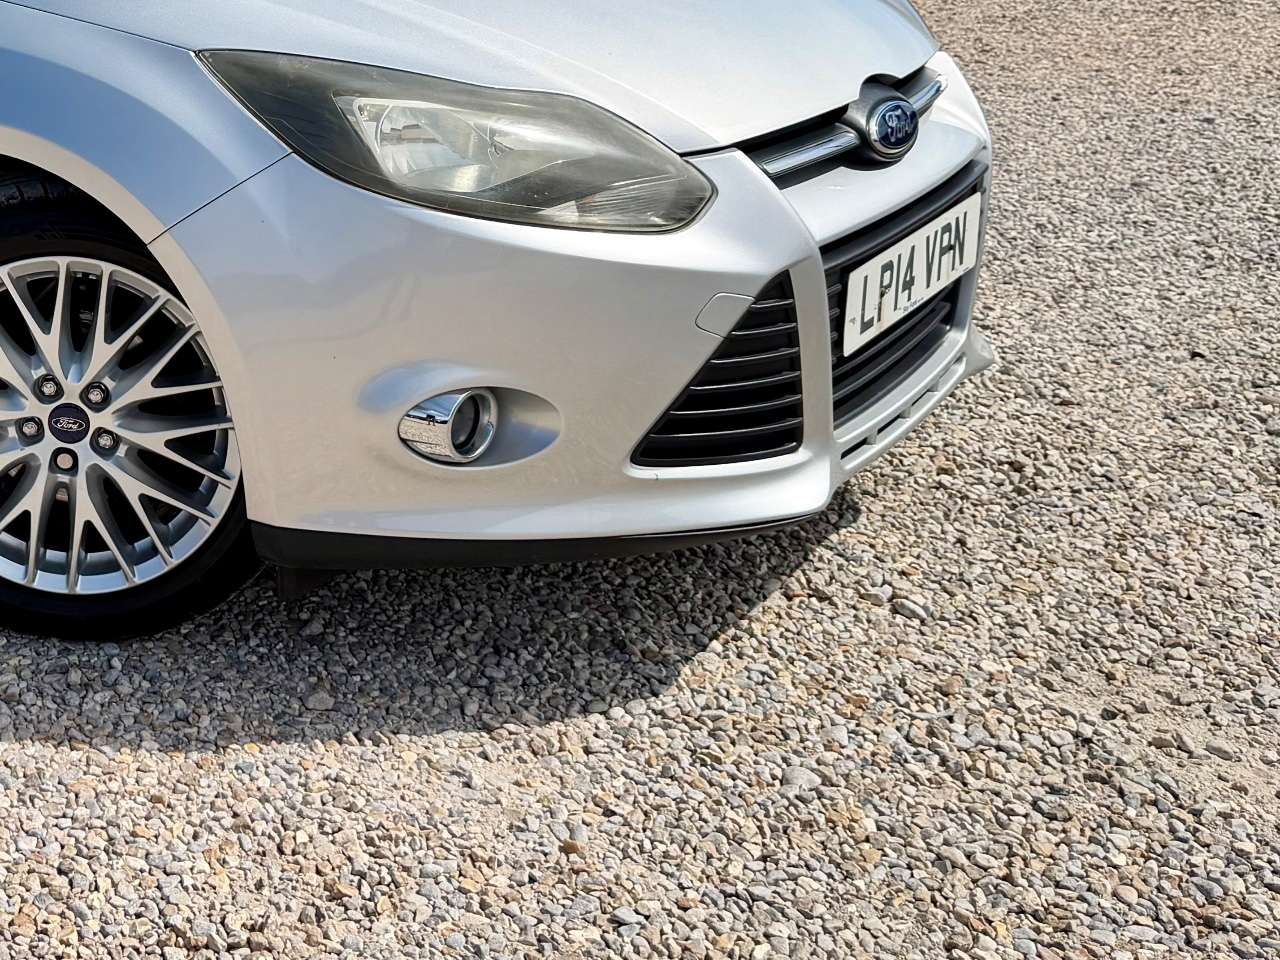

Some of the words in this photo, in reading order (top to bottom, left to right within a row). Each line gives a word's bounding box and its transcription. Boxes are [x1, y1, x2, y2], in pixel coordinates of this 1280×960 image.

[860, 244, 915, 335] LP14
[925, 211, 967, 289] VPN
[56, 419, 80, 430] Ford
